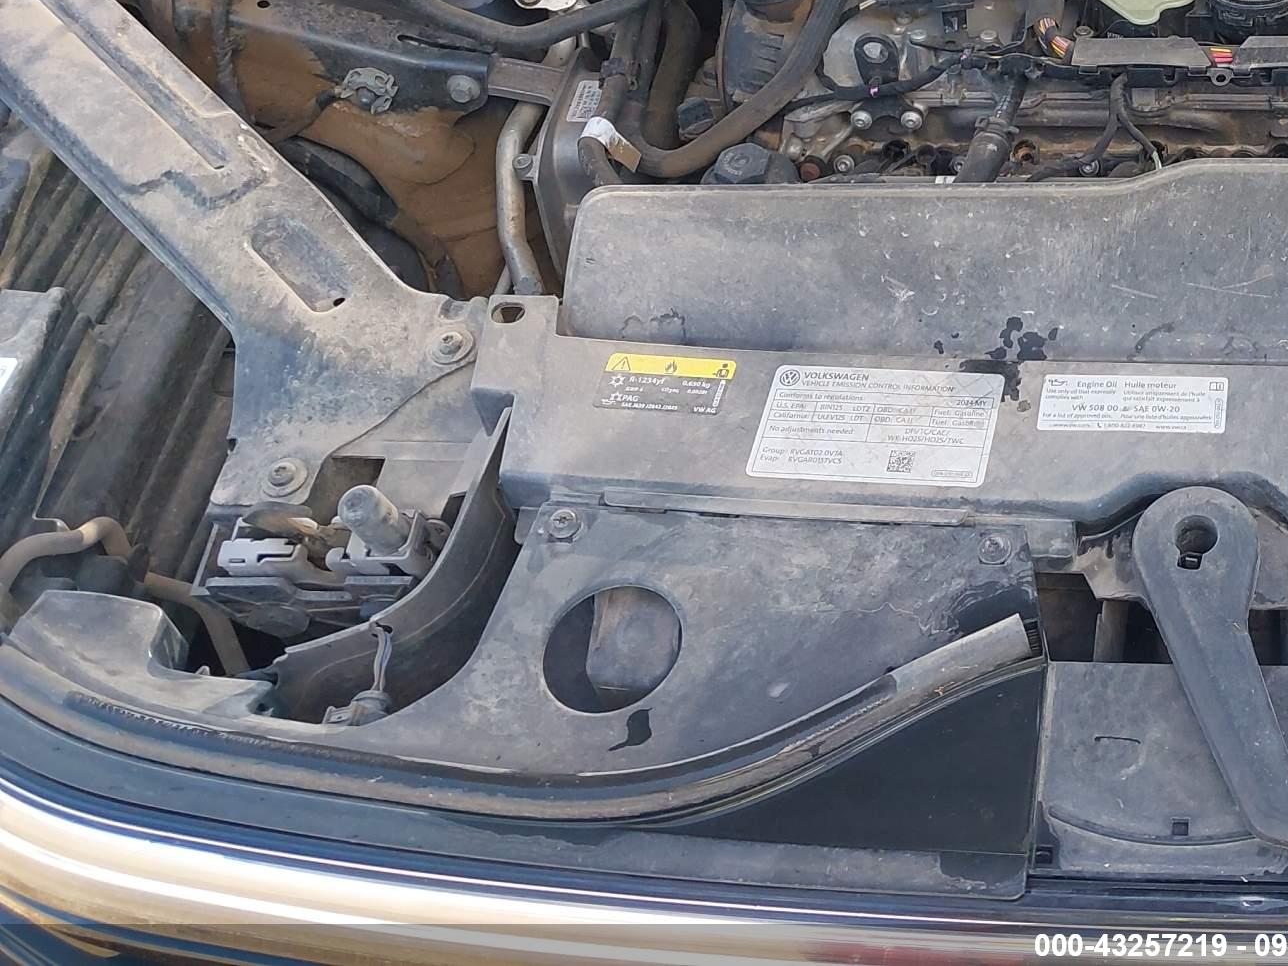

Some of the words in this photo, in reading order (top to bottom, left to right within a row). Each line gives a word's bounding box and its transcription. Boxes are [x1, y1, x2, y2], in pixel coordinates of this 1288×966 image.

[804, 372, 869, 381] VOLKSWAGEN
[903, 384, 955, 392] INFORMATION
[1077, 380, 1104, 389] Engine
[1106, 380, 1118, 388] Oil
[622, 394, 640, 402] PAG
[1071, 403, 1087, 411] VW
[1089, 404, 1105, 412] 508
[1106, 404, 1119, 412] 00
[1133, 405, 1150, 413] SAE
[1151, 405, 1180, 413] 0W-20
[780, 426, 825, 434] adjustments
